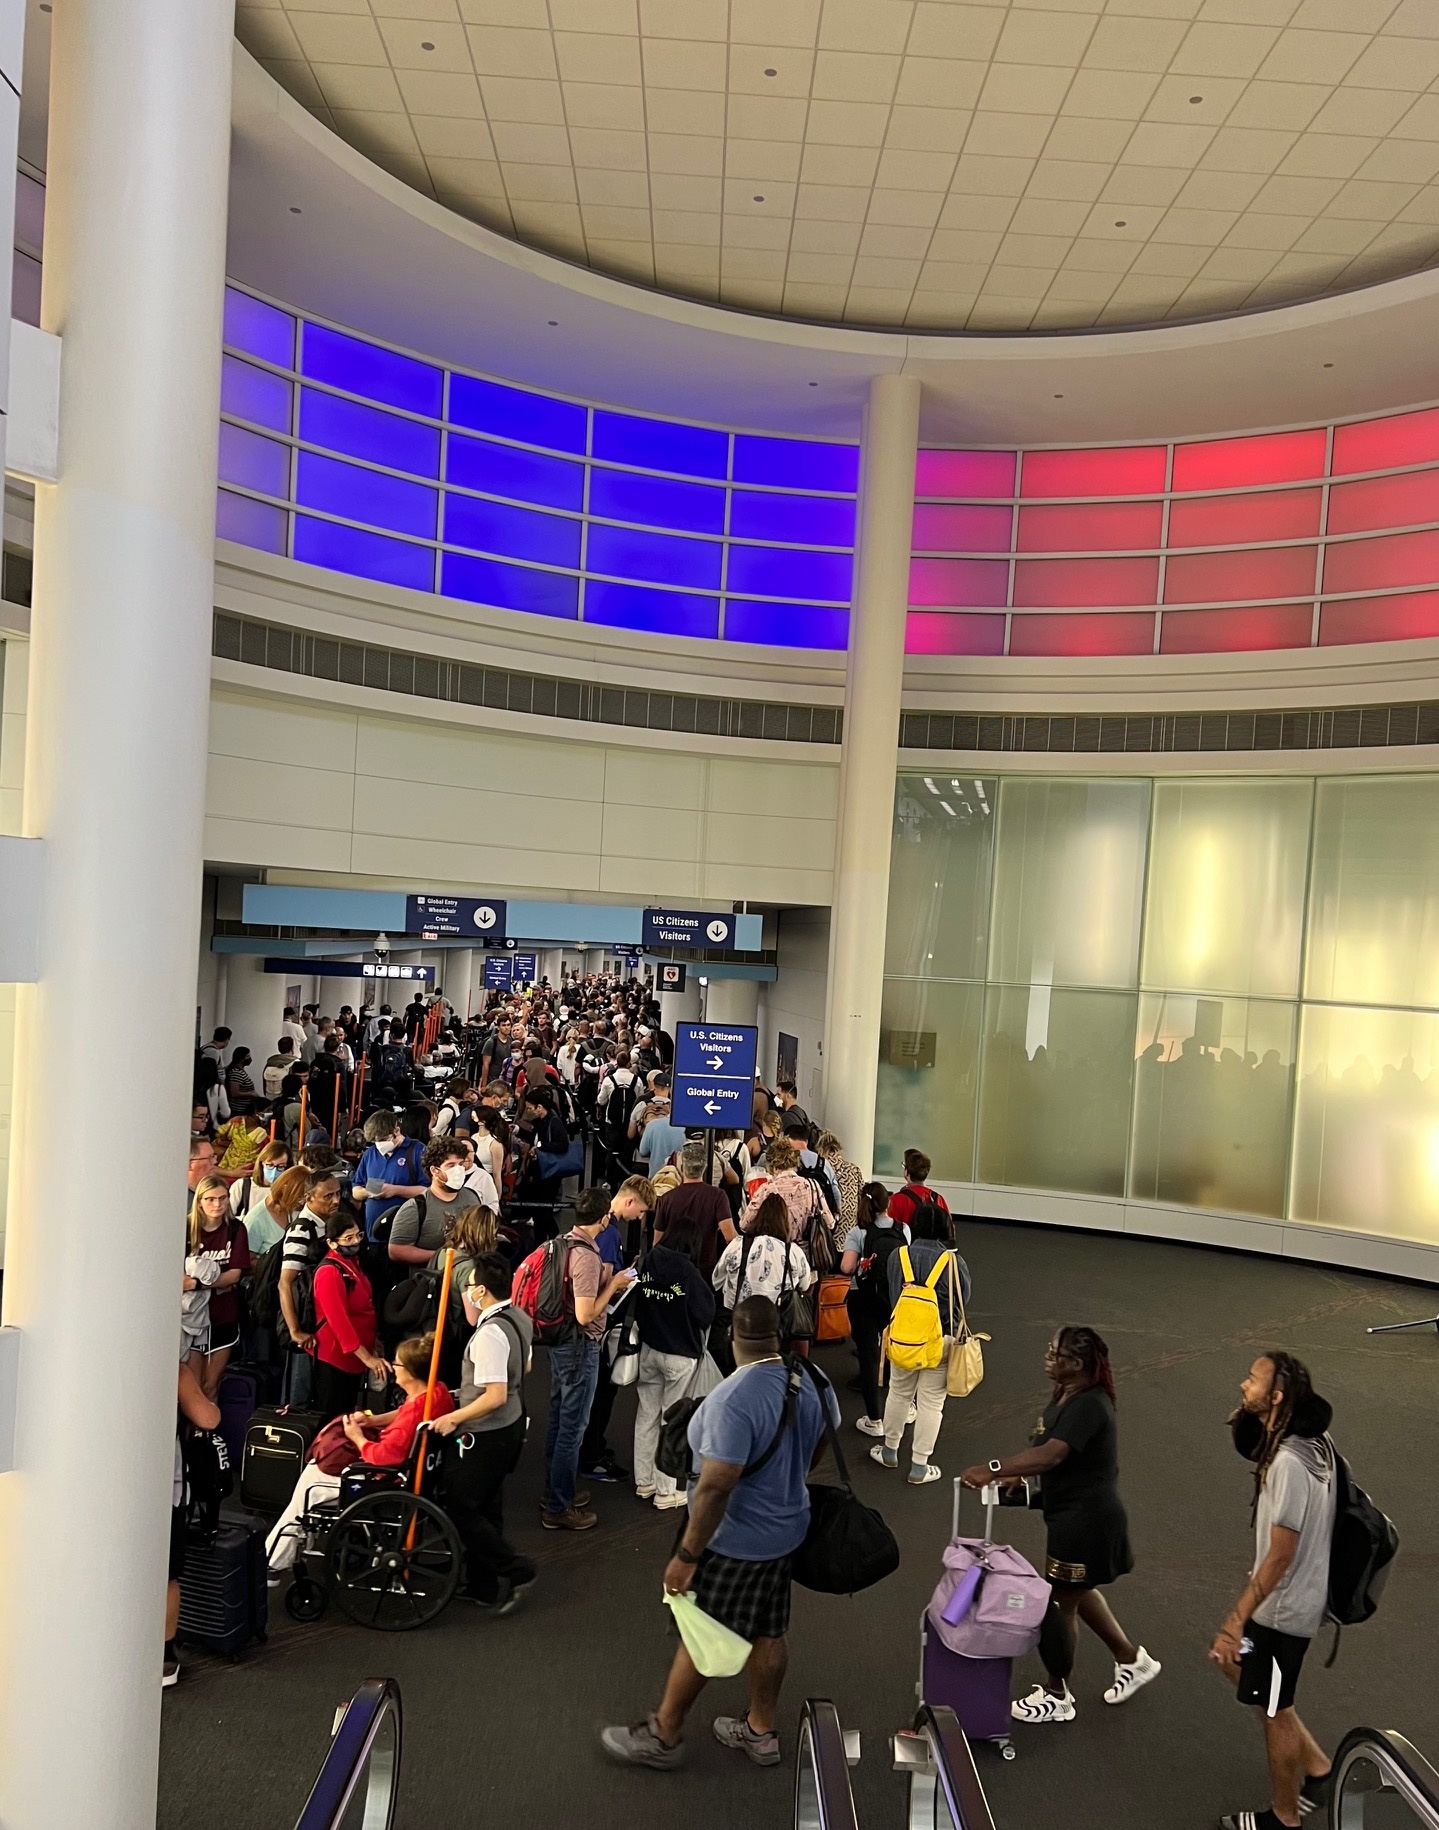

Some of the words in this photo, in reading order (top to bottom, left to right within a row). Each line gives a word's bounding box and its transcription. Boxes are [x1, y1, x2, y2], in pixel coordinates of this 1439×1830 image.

[652, 916, 664, 924] US
[666, 916, 699, 927] Citizens
[659, 930, 691, 941] Visitors
[690, 1030, 707, 1040] U.S.
[709, 1032, 744, 1042] Citizens
[700, 1043, 732, 1052] Visitors
[687, 1087, 714, 1097] Global
[717, 1089, 740, 1100] Entry
